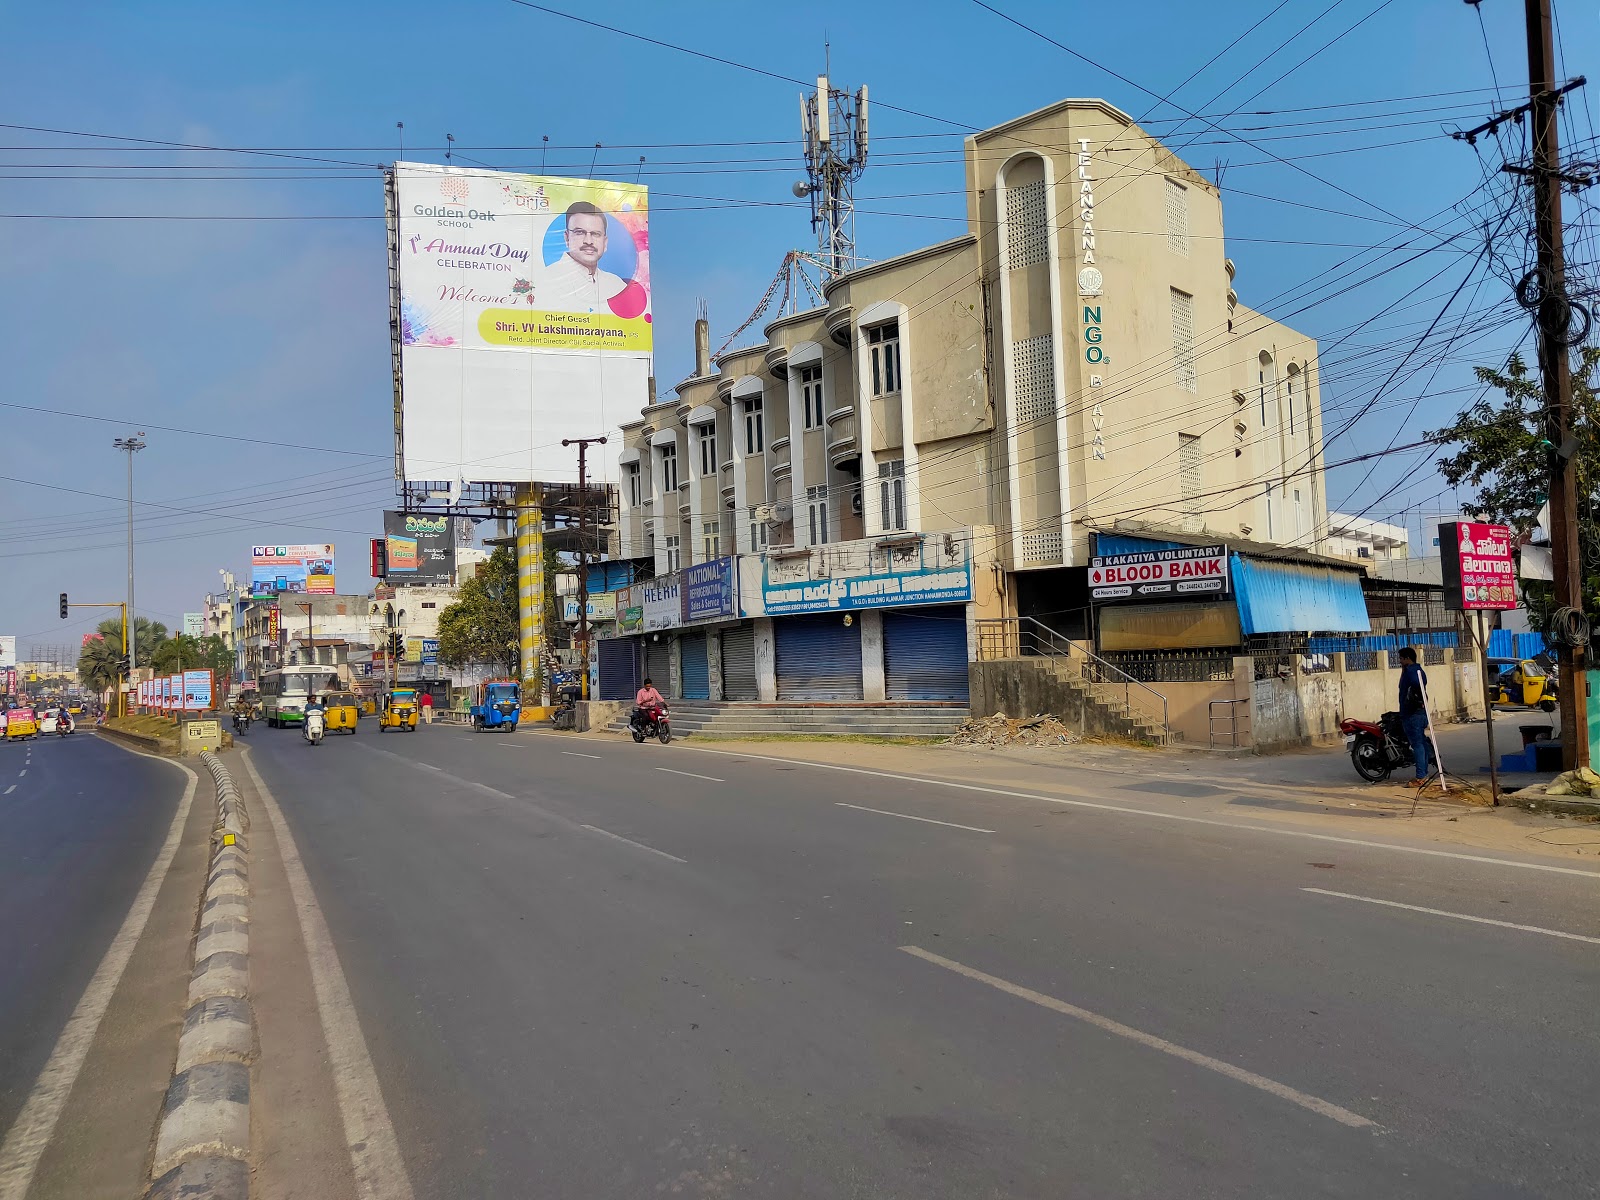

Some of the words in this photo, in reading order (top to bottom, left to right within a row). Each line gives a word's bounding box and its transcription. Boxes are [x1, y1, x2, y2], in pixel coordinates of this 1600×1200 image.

[1077, 138, 1095, 265] TELANGANA
[413, 204, 464, 219] Golden
[468, 209, 496, 221] Oak
[437, 220, 473, 229] SCHOOL
[409, 233, 421, 254] 1st
[424, 238, 487, 256] Annual
[488, 243, 530, 263] Day
[437, 259, 512, 272] CELEBRATION
[437, 284, 519, 304] Welcome's
[544, 314, 566, 323] Chief
[567, 315, 591, 324] Guest
[495, 321, 519, 333] Shri.
[521, 323, 535, 333] VV
[538, 324, 627, 339] Lakshminarayana,
[526, 336, 542, 344] Joint
[543, 337, 568, 345] Director
[1105, 552, 1156, 566] KAKATIYA
[1157, 546, 1220, 561] VOLUNTARY
[1462, 556, 1511, 573] తెలంగాణ
[688, 564, 721, 586] NATIONAL
[1105, 564, 1163, 583] BLOOD
[1169, 559, 1222, 578] BANK
[690, 600, 700, 610] Sales
[704, 597, 719, 608] Service
